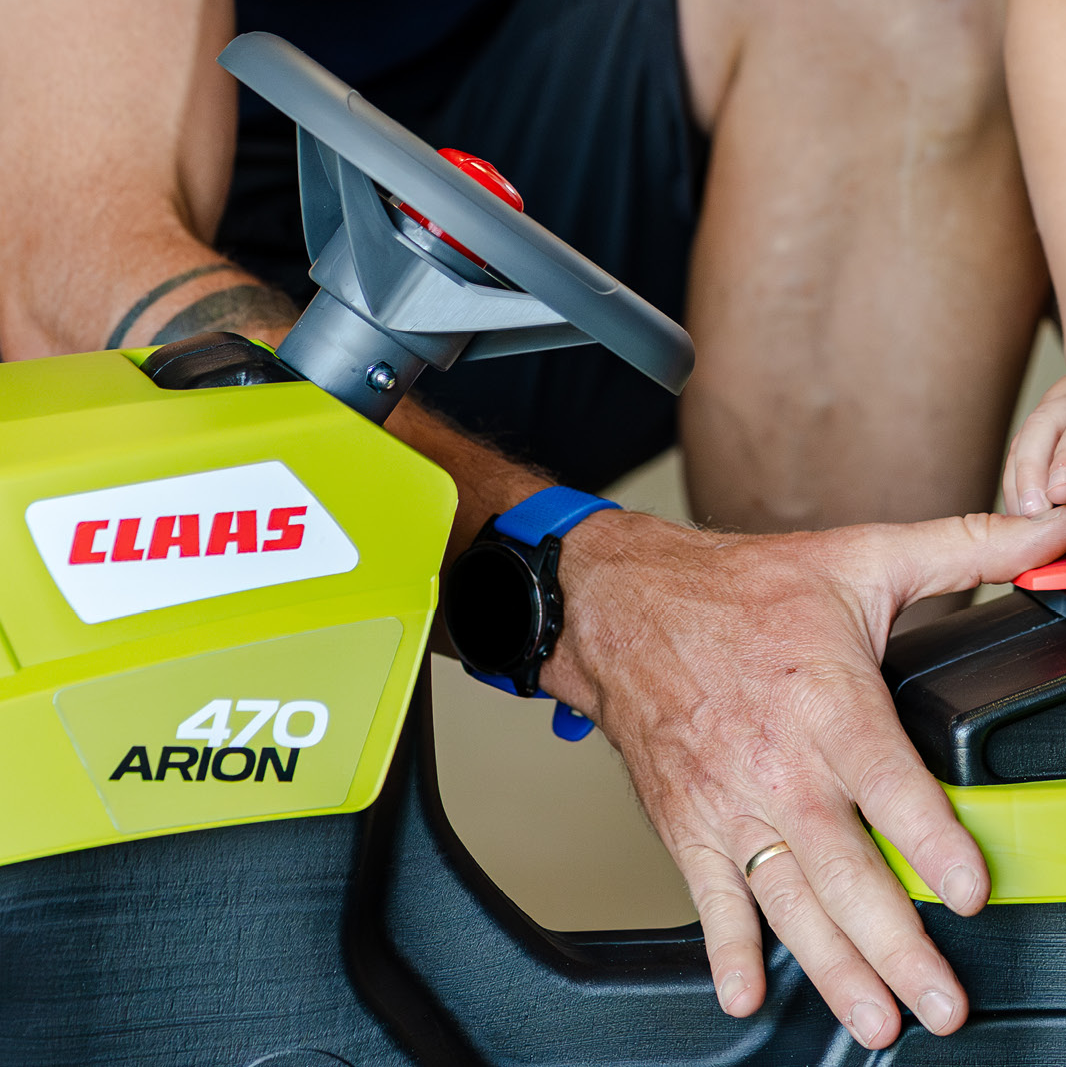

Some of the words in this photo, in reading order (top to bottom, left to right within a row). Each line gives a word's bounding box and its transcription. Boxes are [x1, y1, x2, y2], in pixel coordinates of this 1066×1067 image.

[68, 505, 308, 565] CLAAS
[176, 699, 329, 748] 470
[108, 746, 301, 782] ARION
